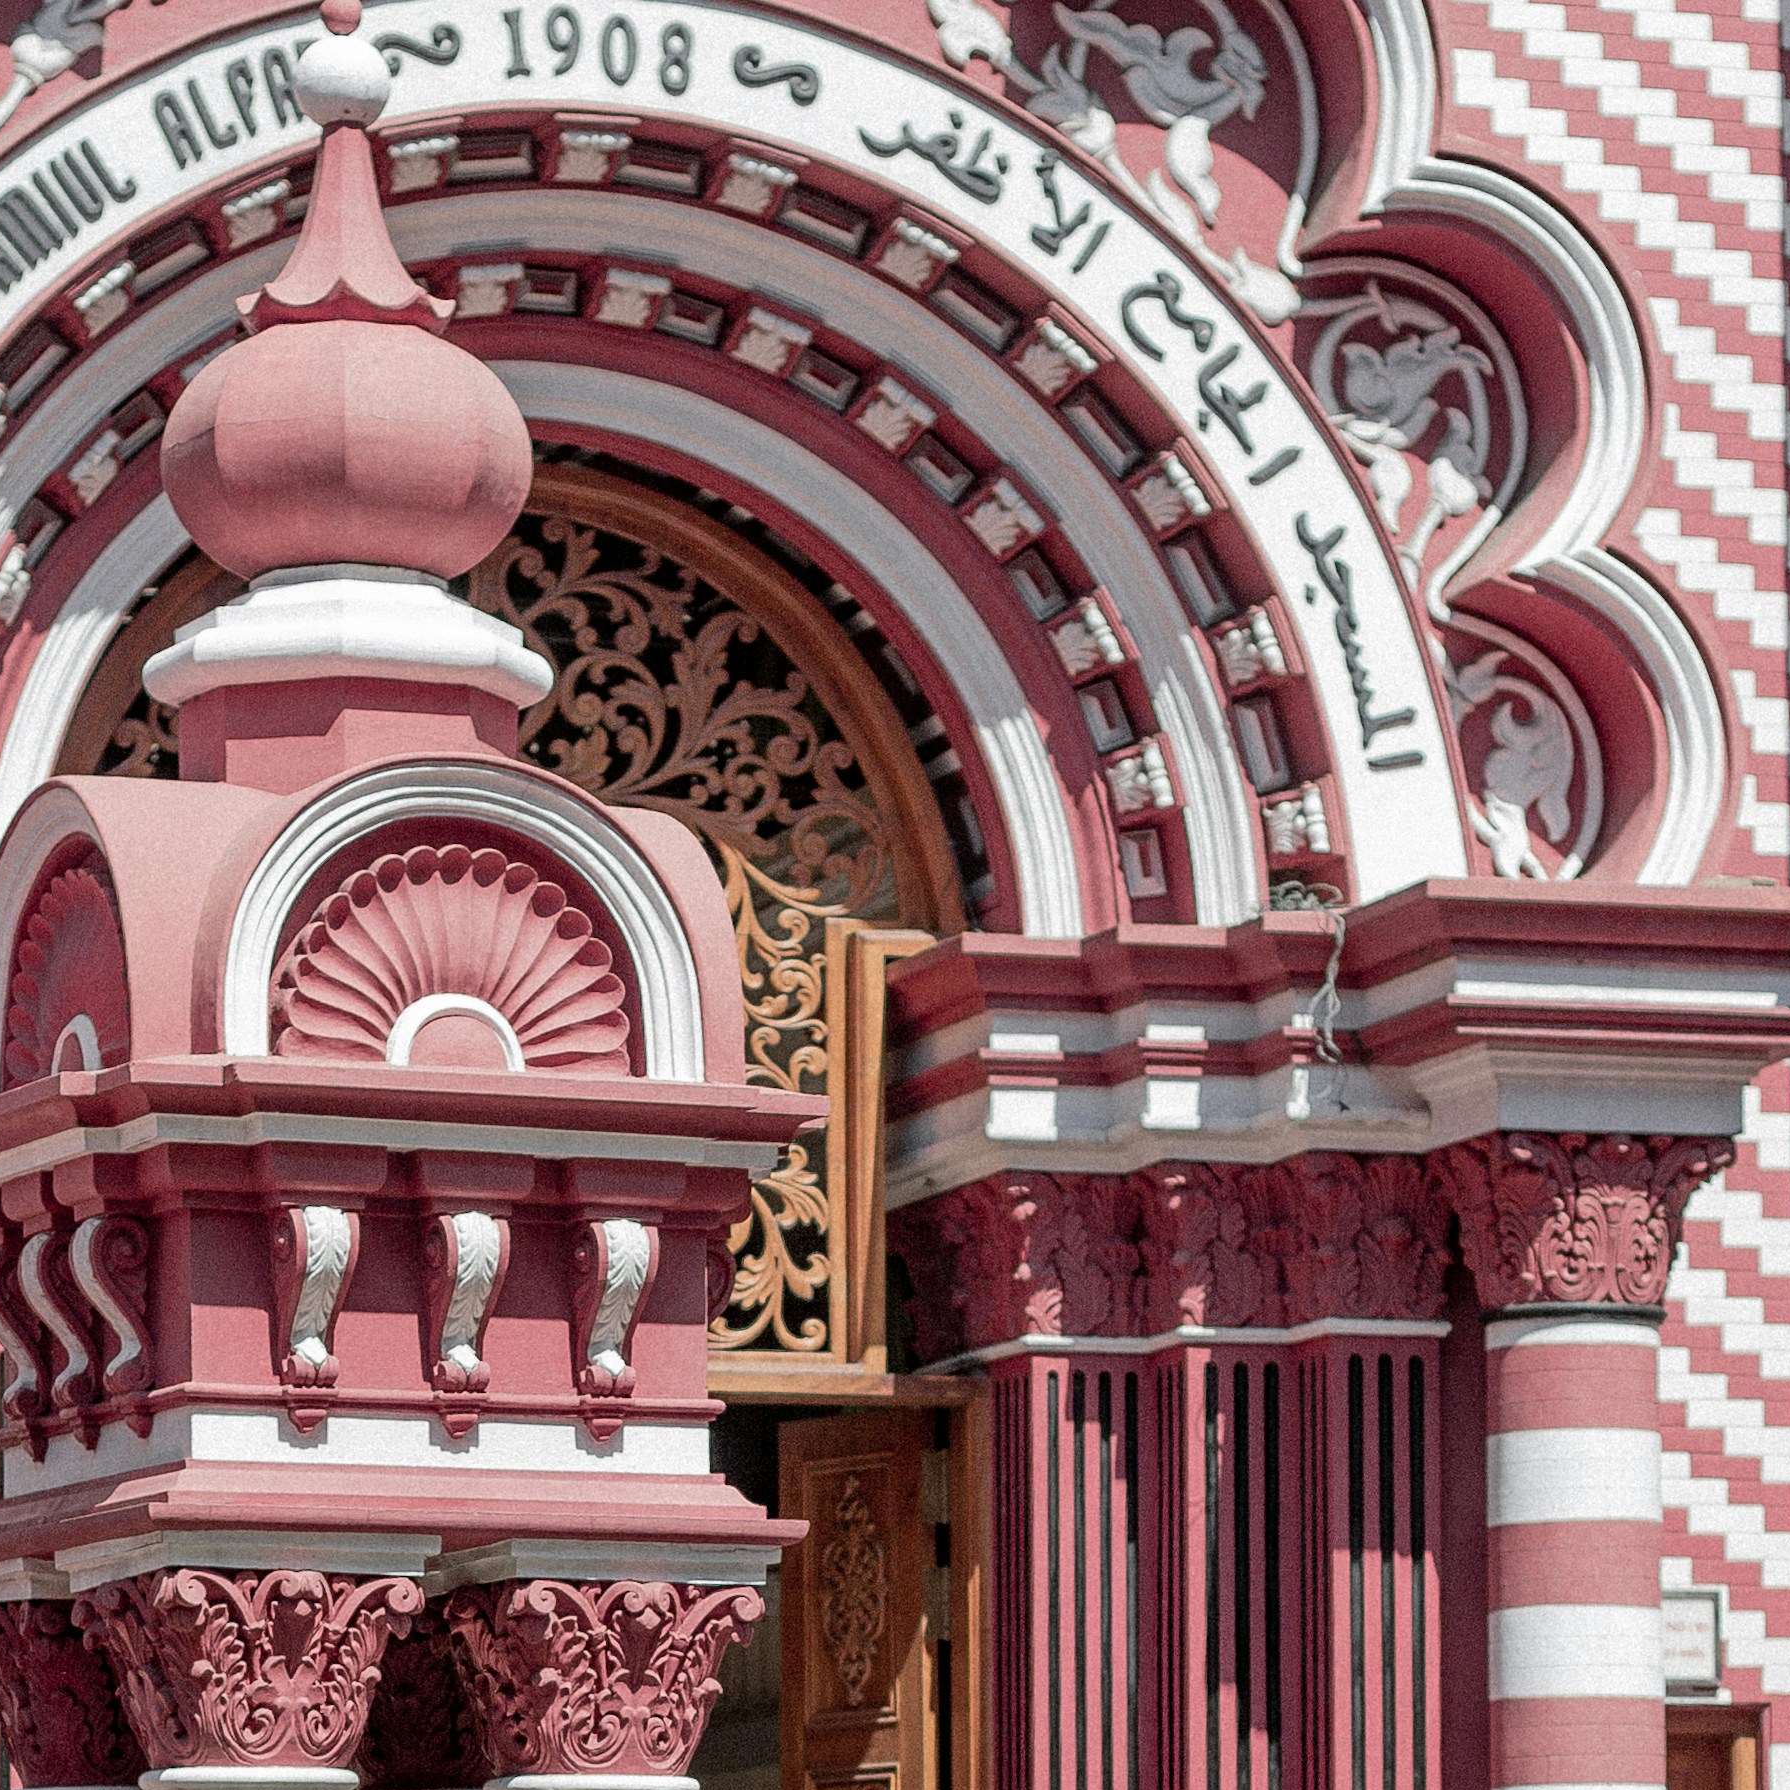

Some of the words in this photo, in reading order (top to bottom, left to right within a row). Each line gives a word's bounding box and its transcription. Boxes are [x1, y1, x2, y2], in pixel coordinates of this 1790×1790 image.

[153, 38, 318, 171] ALFA
[503, 4, 692, 96] 1908
[1120, 268, 1304, 487] الجامع
[1294, 511, 1427, 772] المسجد
